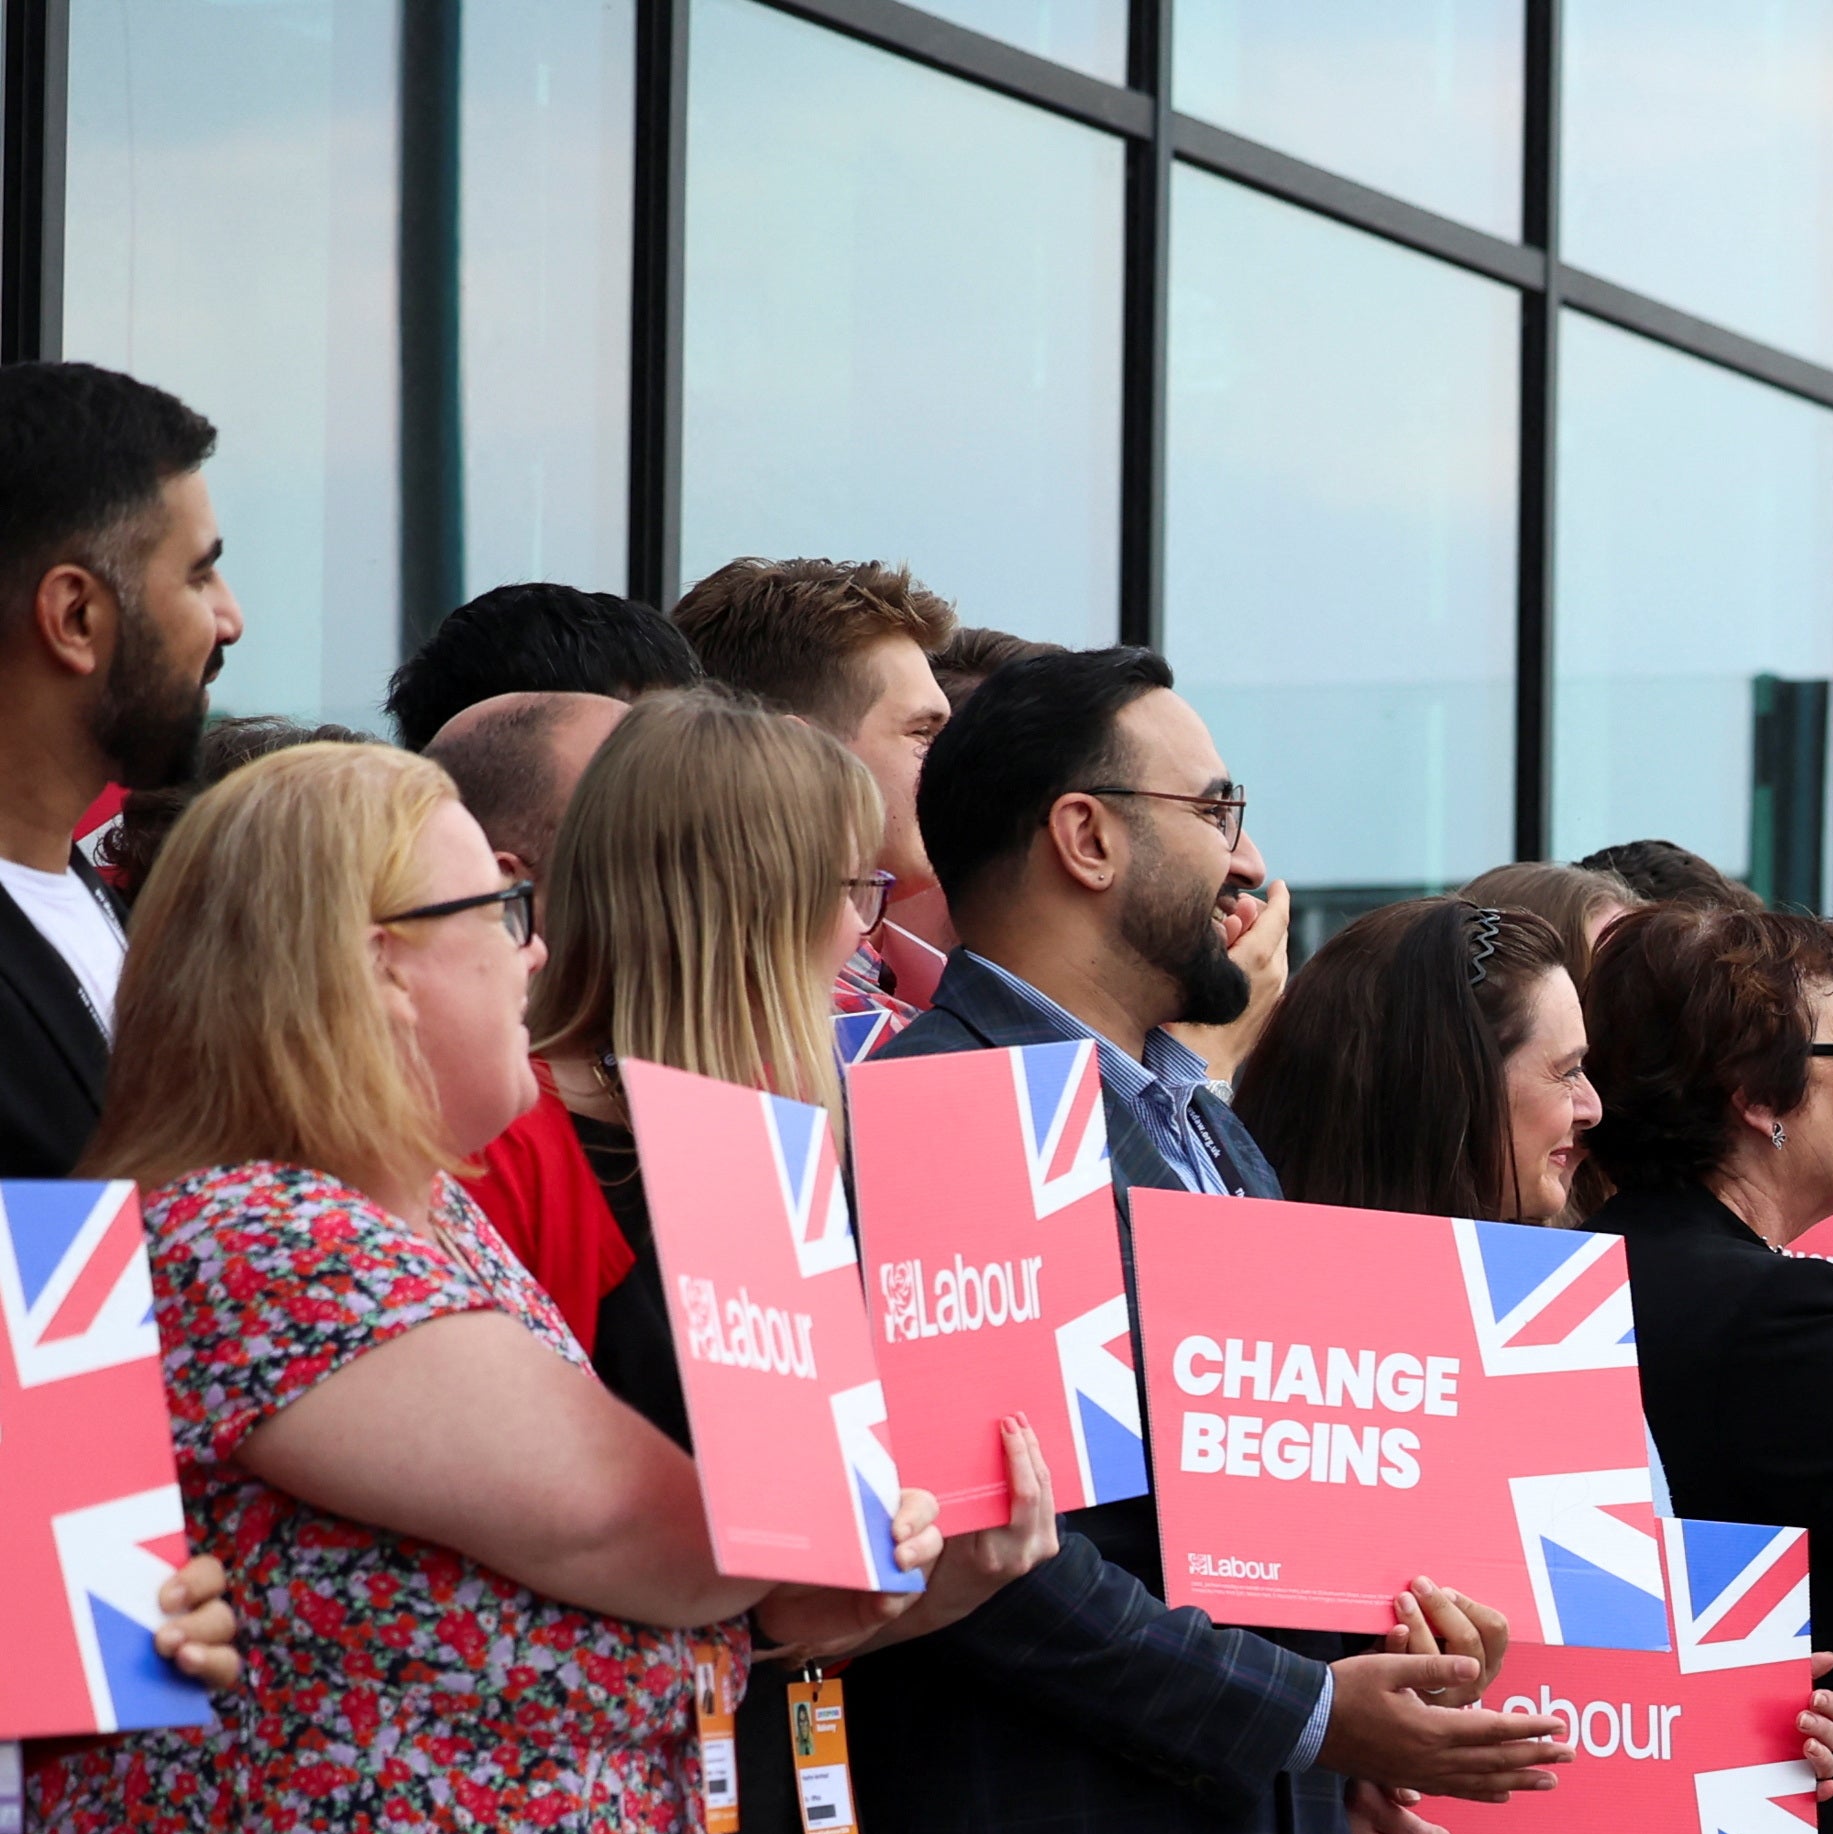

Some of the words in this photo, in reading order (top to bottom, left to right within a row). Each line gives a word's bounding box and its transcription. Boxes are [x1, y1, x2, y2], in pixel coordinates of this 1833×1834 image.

[708, 1280, 817, 1380] Labour
[913, 1253, 1043, 1338] Labour
[1172, 1334, 1460, 1417] CHANGE
[1180, 1411, 1421, 1489] BEGINS
[1207, 1554, 1282, 1580] Labour
